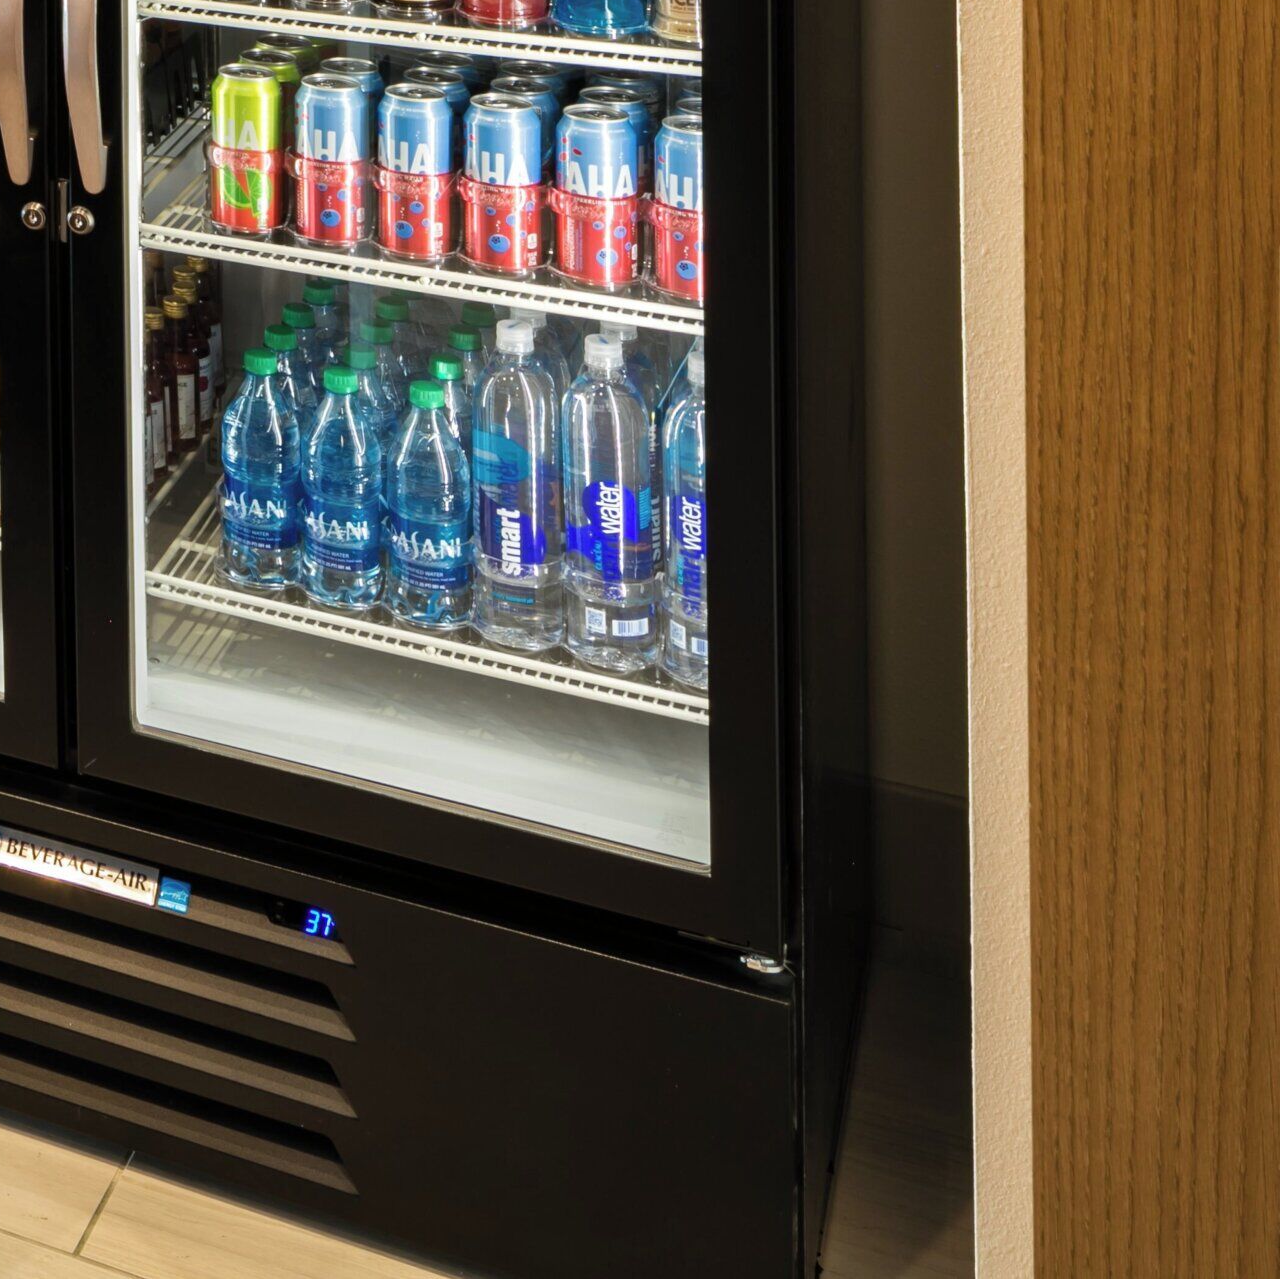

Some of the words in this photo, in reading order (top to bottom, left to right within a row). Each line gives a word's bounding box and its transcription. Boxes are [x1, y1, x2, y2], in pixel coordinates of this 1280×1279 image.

[213, 116, 260, 152] HA
[297, 124, 359, 161] AHA
[378, 135, 434, 175] AHA
[465, 147, 530, 187] AHA
[565, 161, 634, 199] AHA
[223, 490, 287, 520] ASANI
[304, 508, 370, 542] ASANI
[497, 507, 522, 576] smart
[391, 527, 462, 561] ASANI
[6, 836, 149, 893] BEVERAGE-AIR
[305, 909, 334, 937] 37
